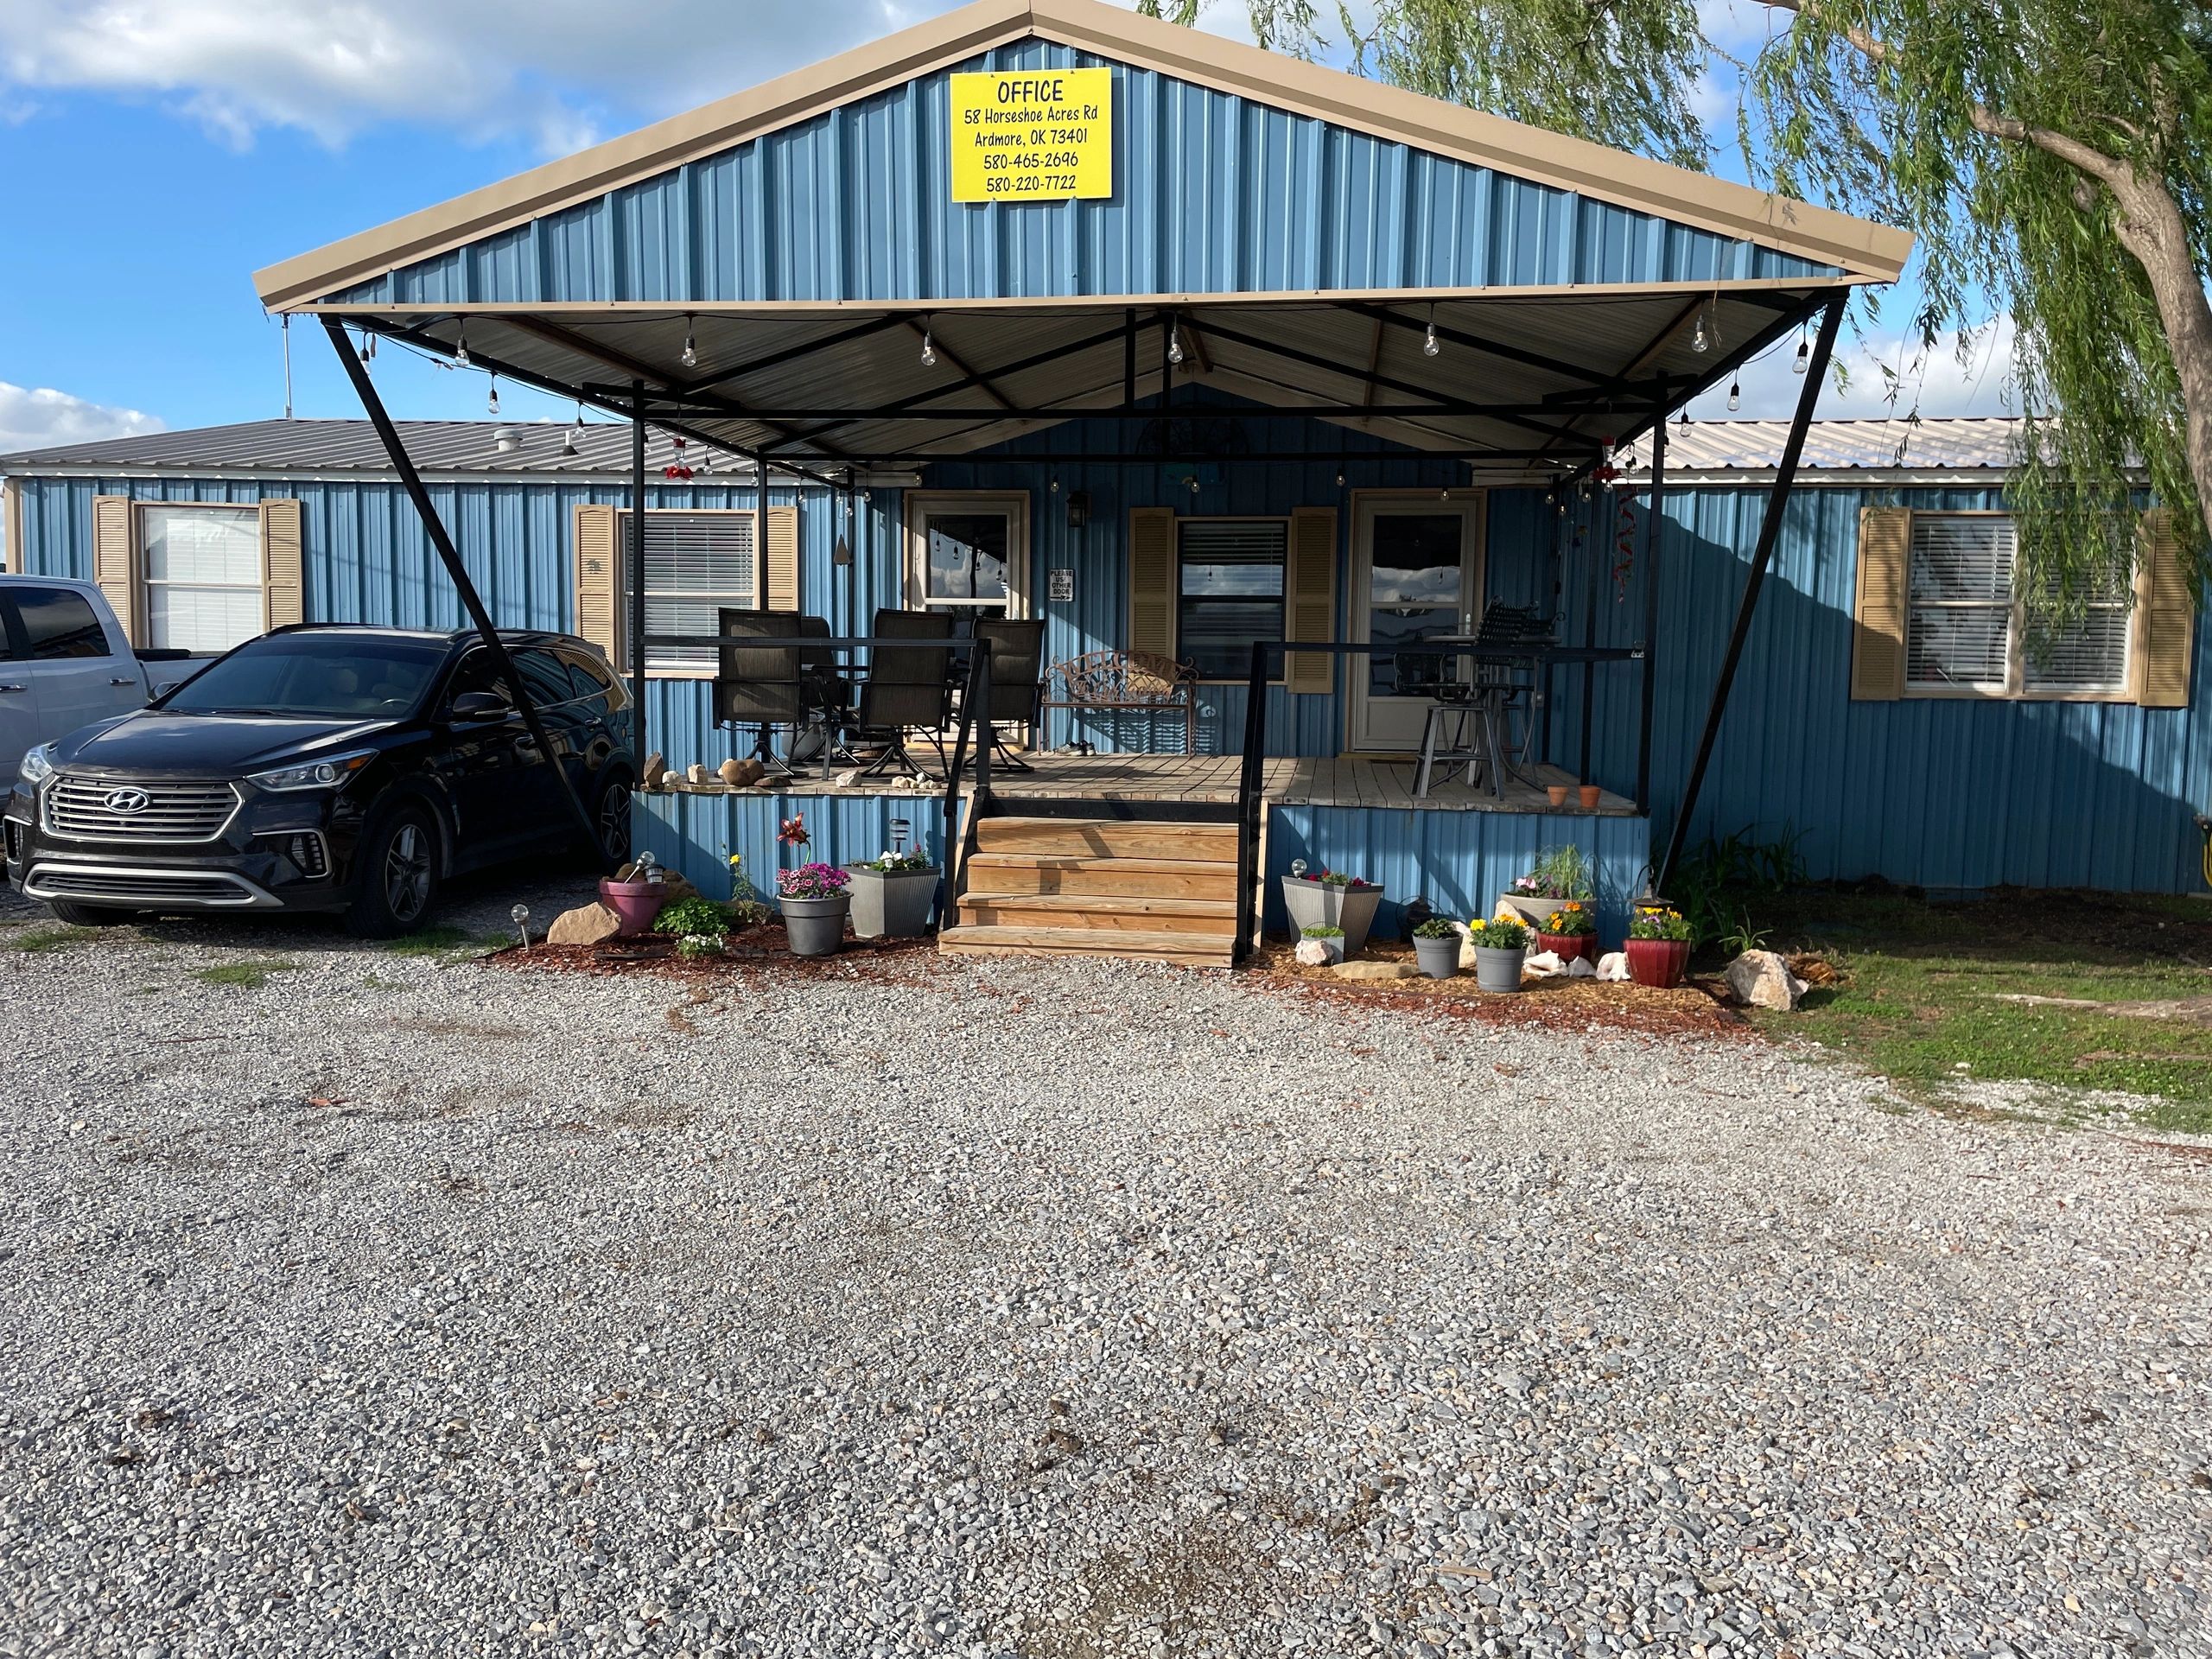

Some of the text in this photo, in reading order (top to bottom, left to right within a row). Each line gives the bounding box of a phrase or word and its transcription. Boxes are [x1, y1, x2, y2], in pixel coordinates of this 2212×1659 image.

[997, 79, 1064, 104] OFFICE
[964, 105, 1098, 124] 58 Horseshoe Acres Rd
[975, 128, 1088, 148] Ardmore, OK 73401
[983, 151, 1078, 169] 580-465-2696
[986, 175, 1077, 192] 580-220-7722
